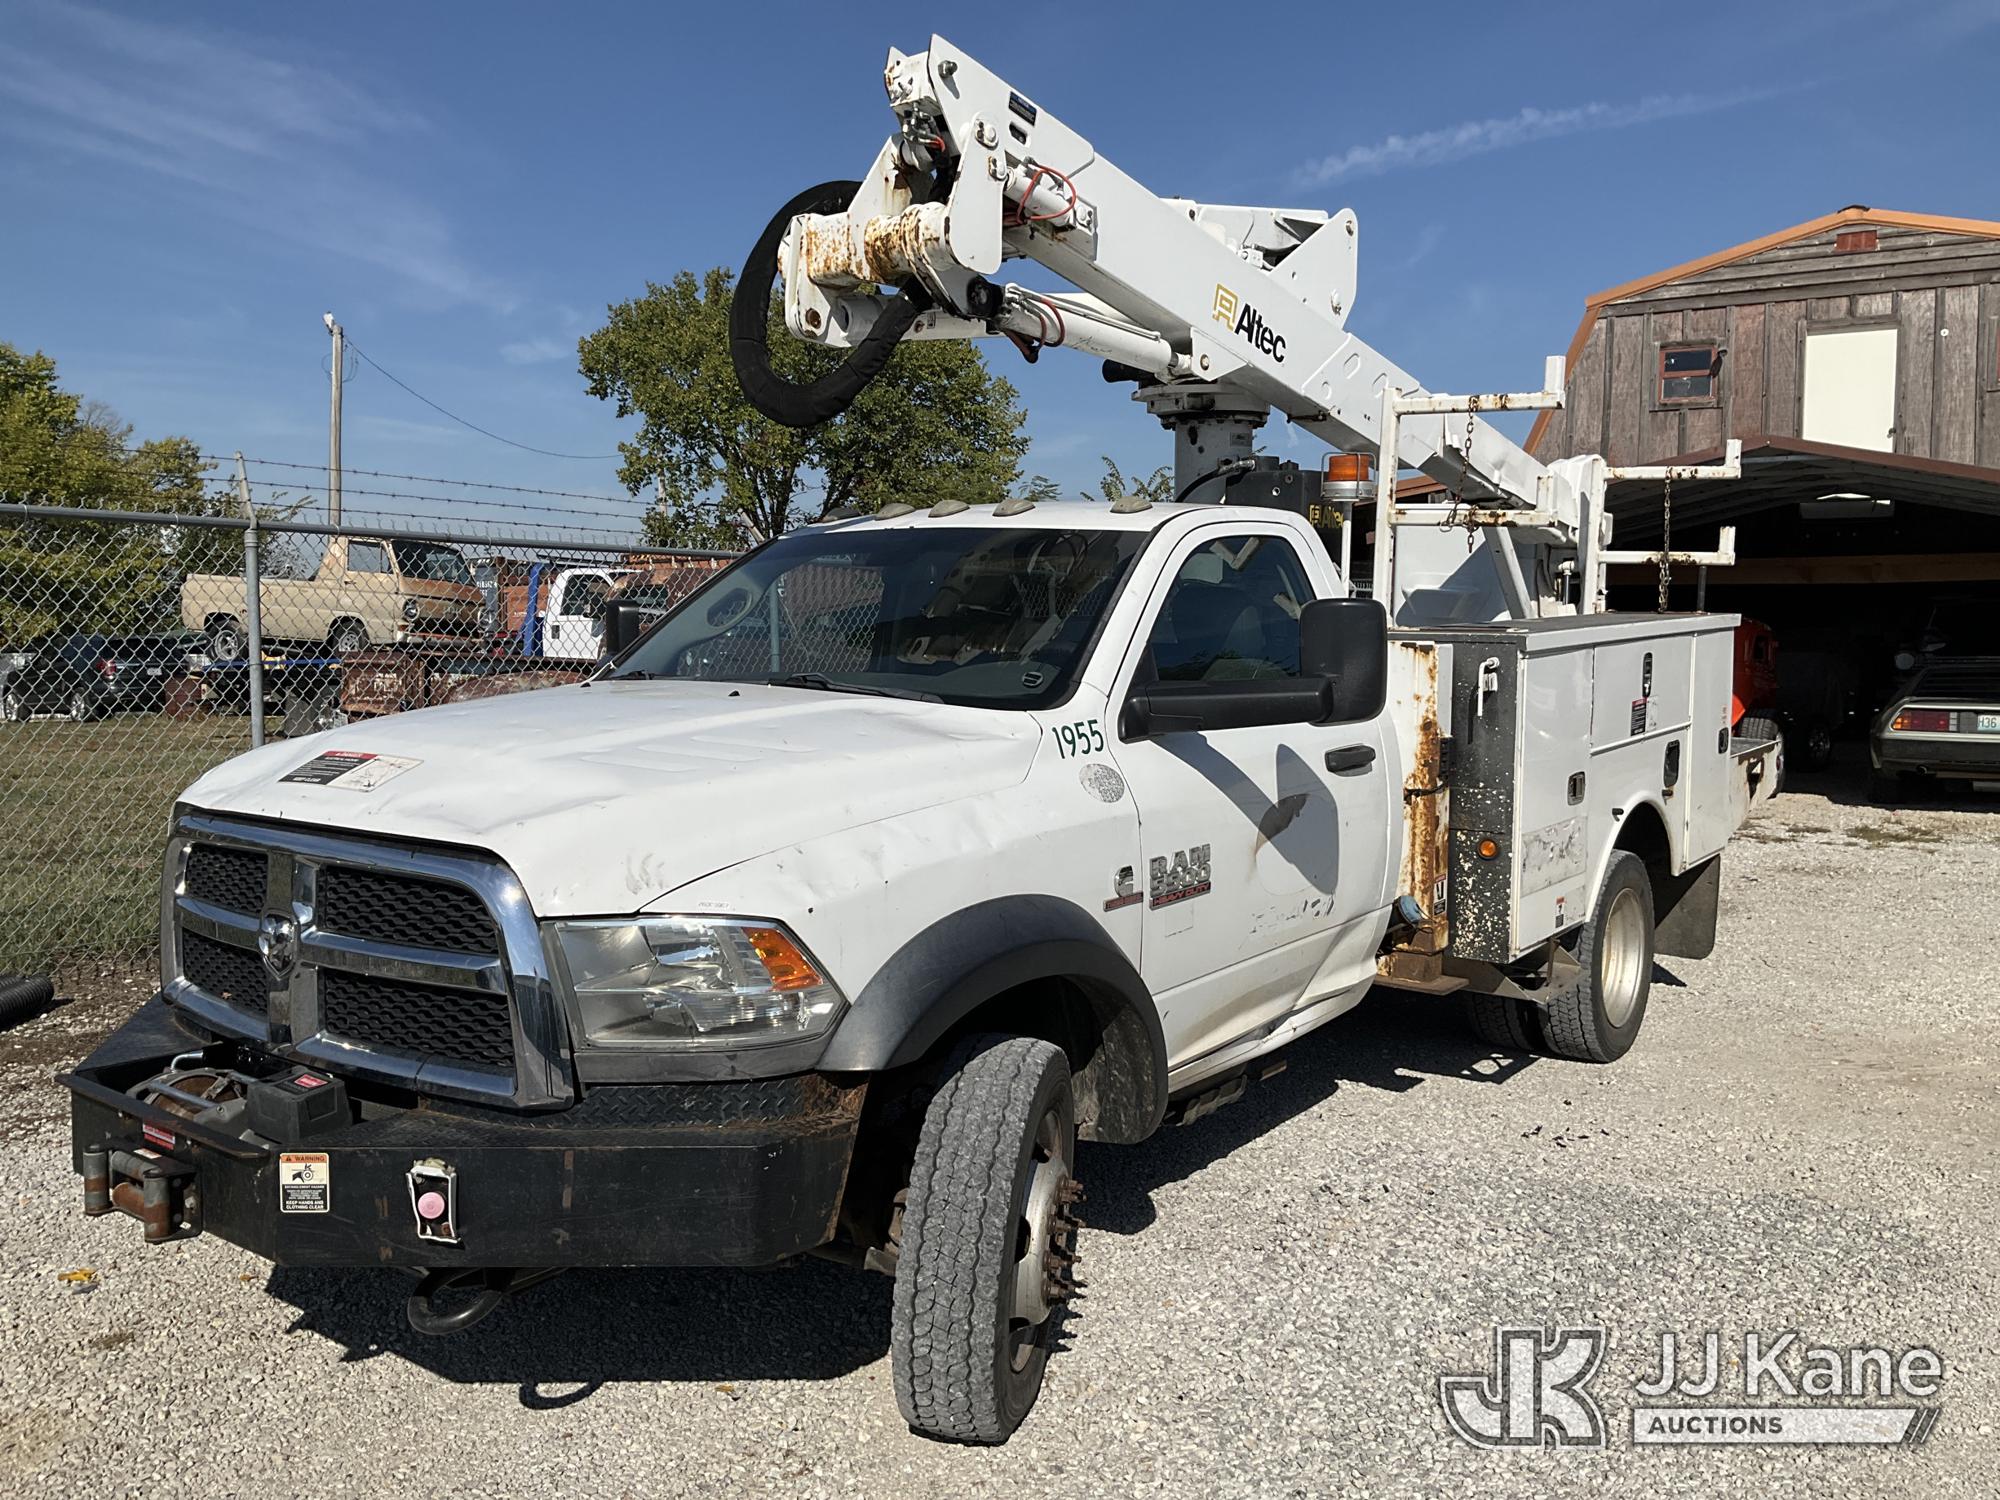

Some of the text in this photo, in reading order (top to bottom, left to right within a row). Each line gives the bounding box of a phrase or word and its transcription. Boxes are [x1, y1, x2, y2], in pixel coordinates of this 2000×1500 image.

[1234, 302, 1287, 363] Altec
[1051, 718, 1104, 759] 1955
[1149, 843, 1211, 880] RAM
[1149, 862, 1211, 899] 5500
[1184, 881, 1211, 897] DUTY
